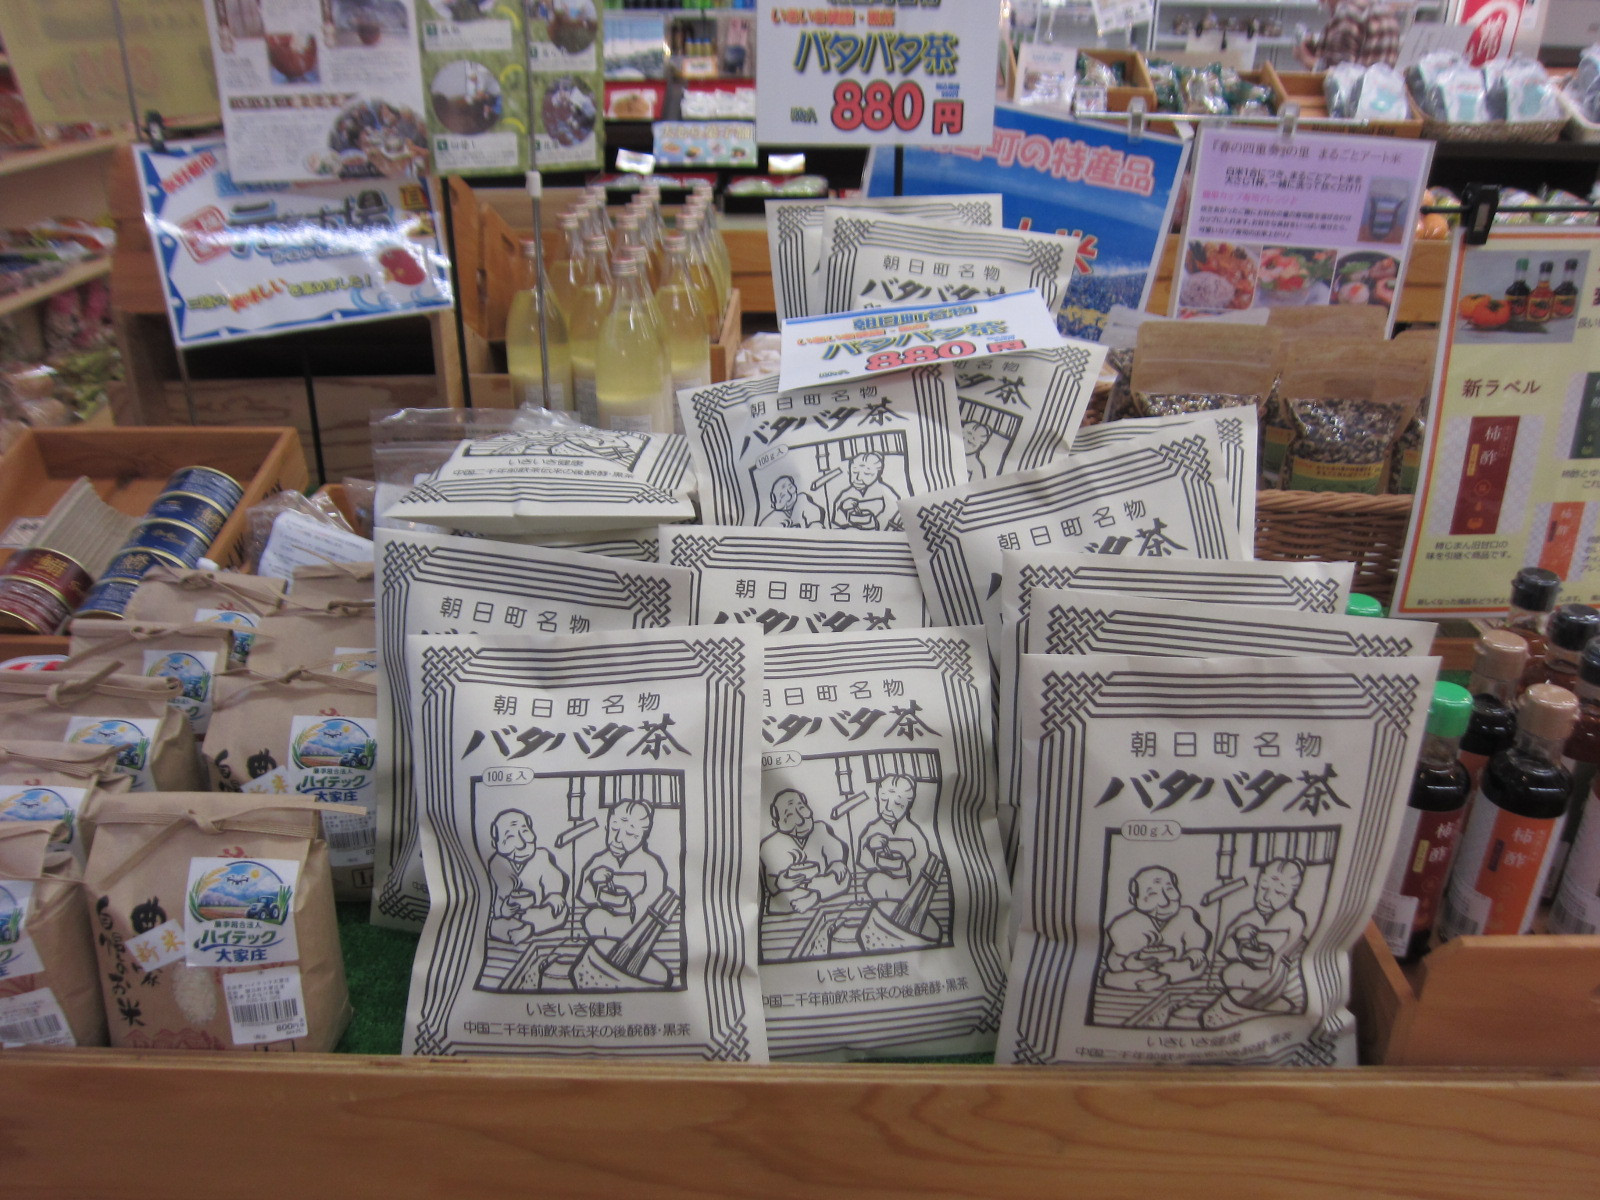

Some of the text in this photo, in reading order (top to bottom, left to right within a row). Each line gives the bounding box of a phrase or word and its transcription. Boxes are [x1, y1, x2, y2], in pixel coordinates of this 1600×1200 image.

[792, 31, 959, 76] バタバタ茶
[922, 124, 1156, 198] 町の特産品
[883, 254, 1001, 282] 朝日町名物
[860, 277, 1007, 302] バタバタ
[820, 319, 1011, 361] バタバタ茶
[750, 385, 879, 417] 朝日町名物
[1461, 378, 1542, 399] 新ラベル
[738, 396, 911, 461] バタバタ茶
[997, 499, 1147, 551] 朝日町名物
[735, 578, 884, 604] 朝日町名物
[440, 596, 591, 635] 朝日町名物
[493, 692, 661, 718] 朝日町名物
[460, 712, 693, 761] バタバタ茶
[1130, 730, 1323, 758] 朝日町名物
[761, 753, 796, 768] 00g入
[301, 774, 366, 789] ハイテック
[1093, 762, 1352, 818] バタバタ茶
[315, 790, 358, 802] 大家庄
[200, 929, 278, 945] ハイテック
[215, 948, 269, 962] 大家庄
[817, 960, 910, 984] いきいき健康
[525, 1001, 623, 1018] いきいき健康
